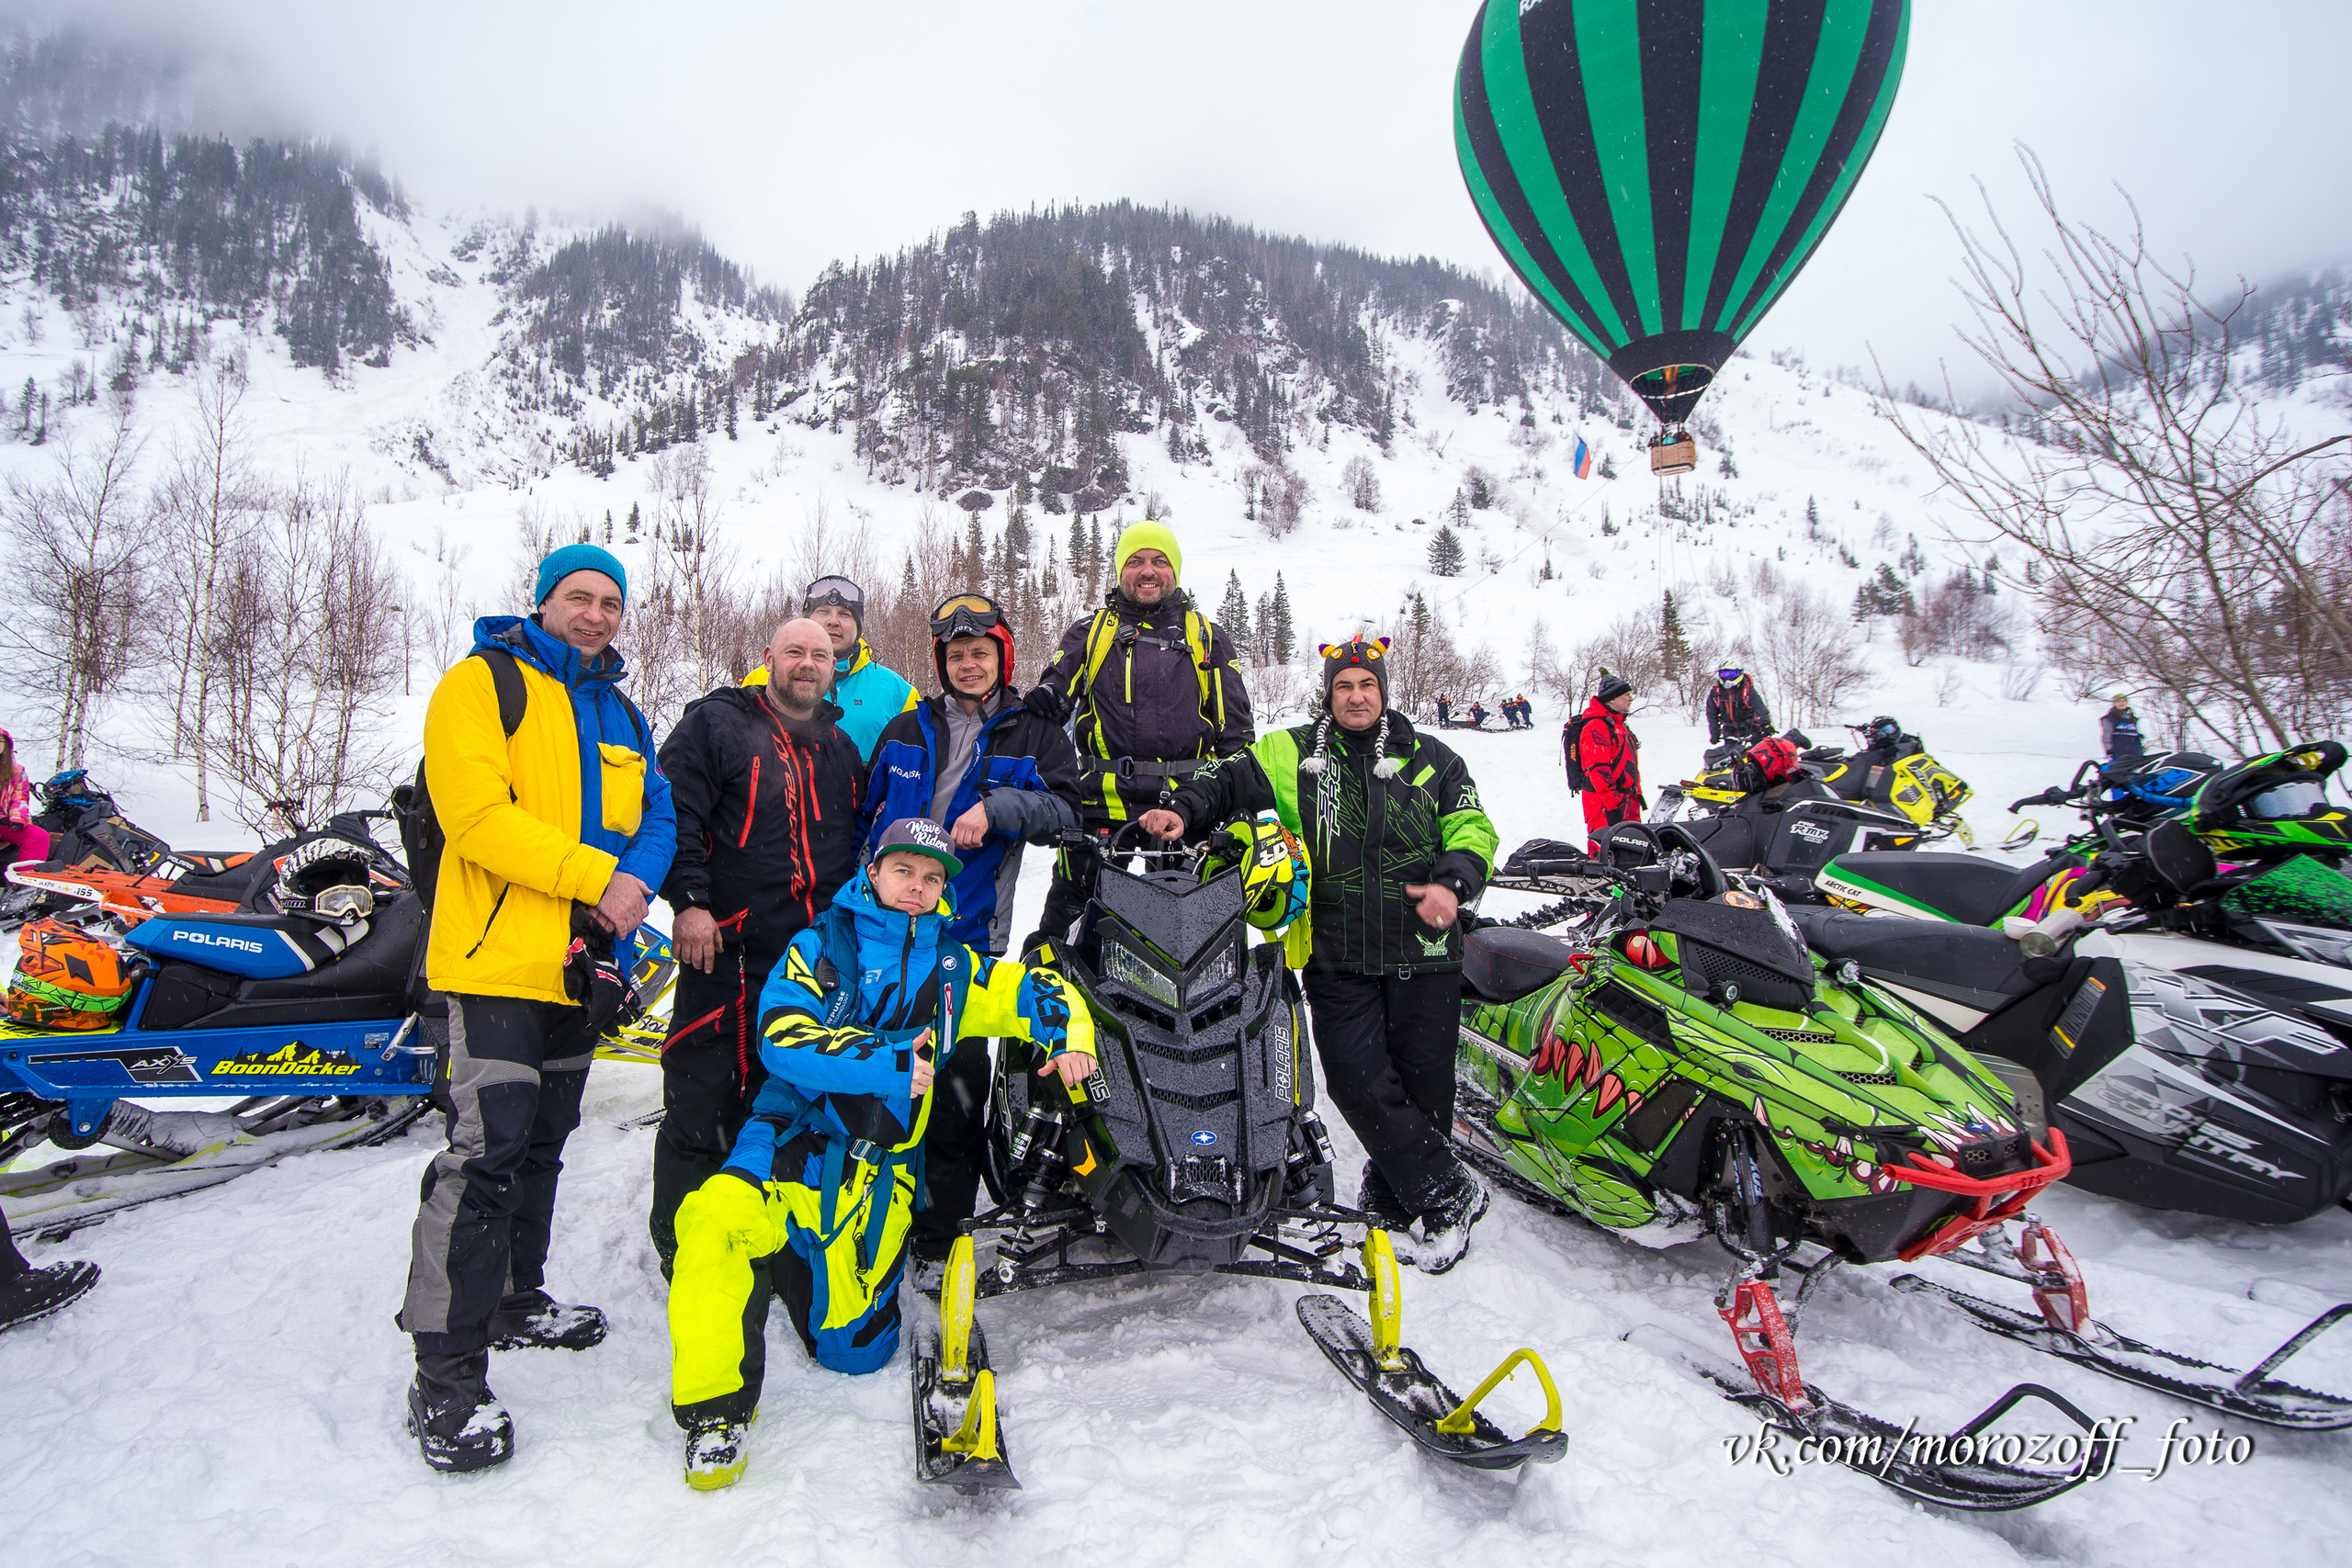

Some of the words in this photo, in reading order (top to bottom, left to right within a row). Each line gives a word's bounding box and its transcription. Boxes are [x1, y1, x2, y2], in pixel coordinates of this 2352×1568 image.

[772, 733, 806, 901] Dragonfly
[905, 819, 941, 835] Wave
[1611, 835, 1649, 847] POLARI
[167, 854, 196, 871] POLARIS
[76, 887, 93, 897] 155
[1824, 880, 1848, 893] ARCTIC
[1847, 888, 1862, 897] CAT
[173, 931, 263, 953] POLARIS
[130, 1055, 198, 1075] AXYS
[209, 1060, 362, 1076] BoonDocker
[1274, 1025, 1291, 1102] POLARIS
[2105, 1075, 2264, 1150] CROSS
